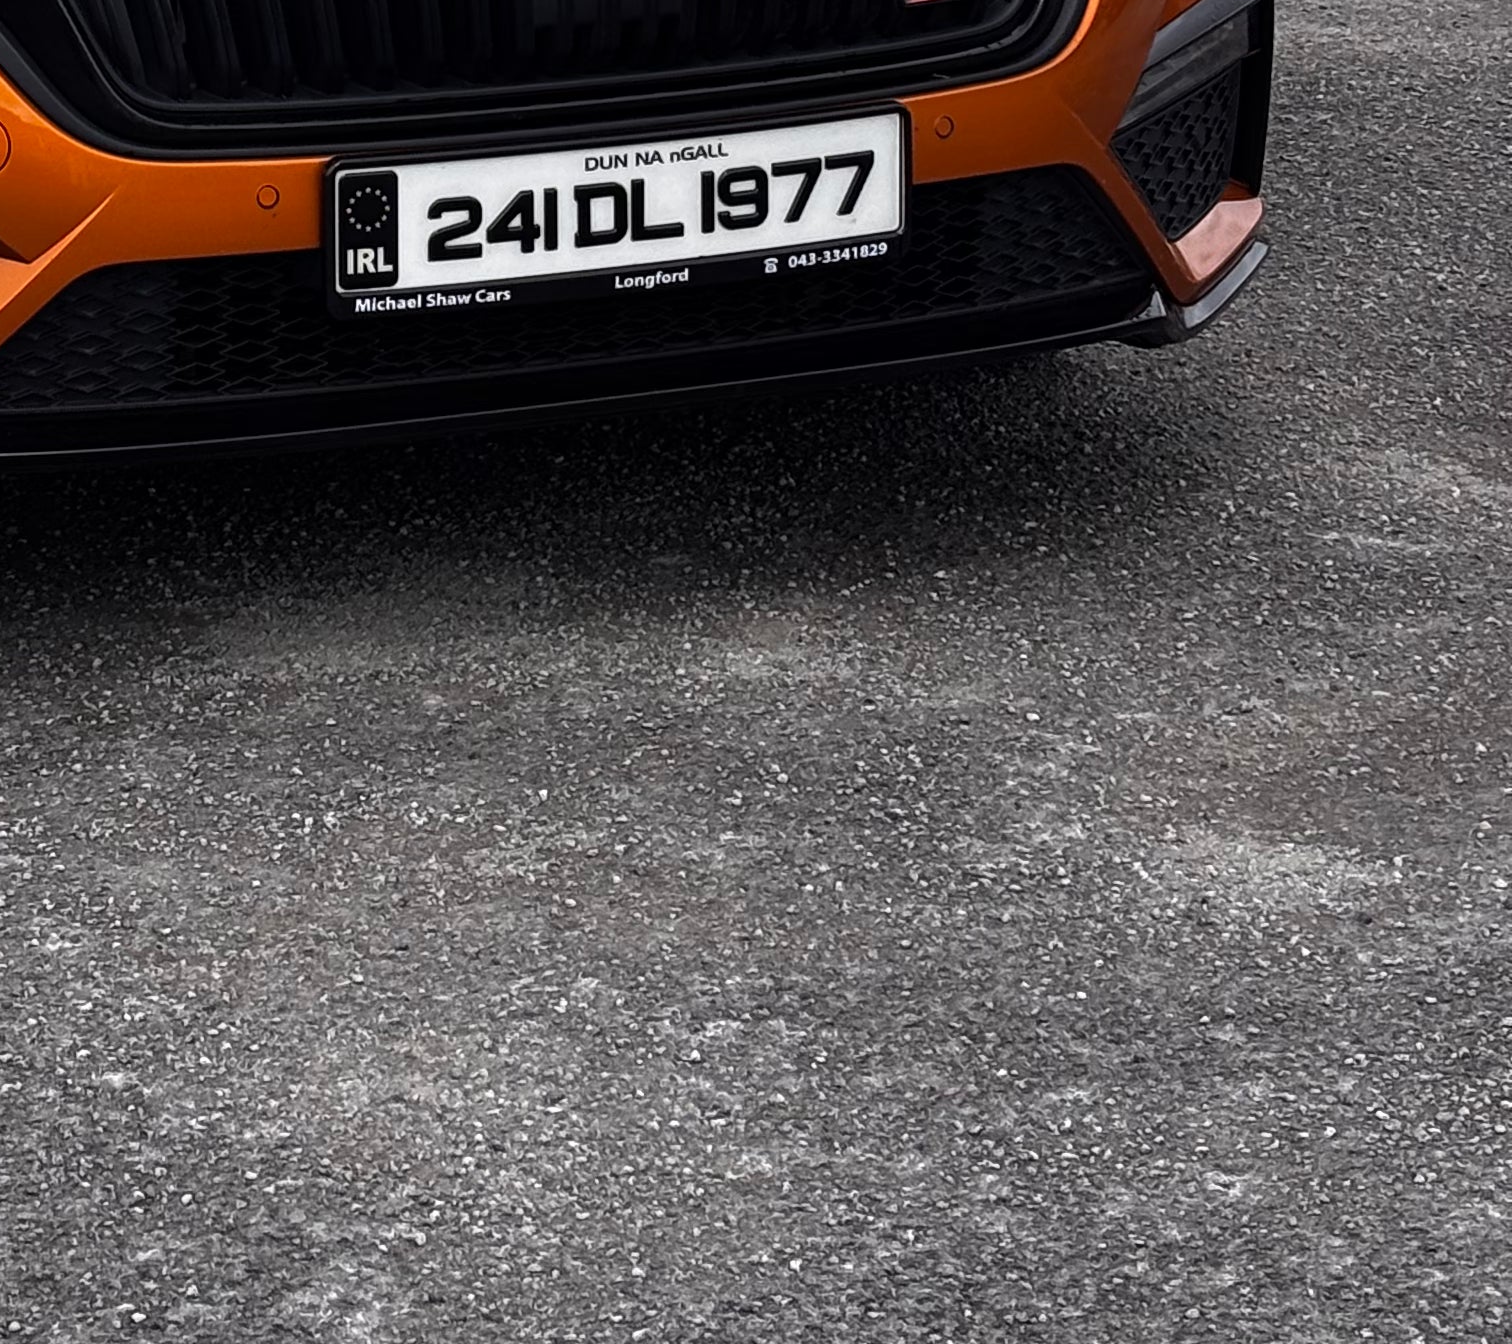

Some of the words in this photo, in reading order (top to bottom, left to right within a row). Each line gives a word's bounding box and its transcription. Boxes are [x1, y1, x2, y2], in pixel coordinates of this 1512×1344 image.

[584, 153, 628, 172] DUN
[635, 150, 664, 167] NA
[669, 142, 729, 163] nGALL
[427, 187, 558, 262] 241
[574, 178, 685, 248] DL
[701, 150, 875, 234] 1977
[346, 247, 394, 275] IRL
[788, 242, 888, 269] 043-3341829
[614, 268, 689, 290] Longford
[355, 291, 422, 313] Michael
[425, 291, 471, 308] Shaw
[475, 288, 512, 303] Cars
